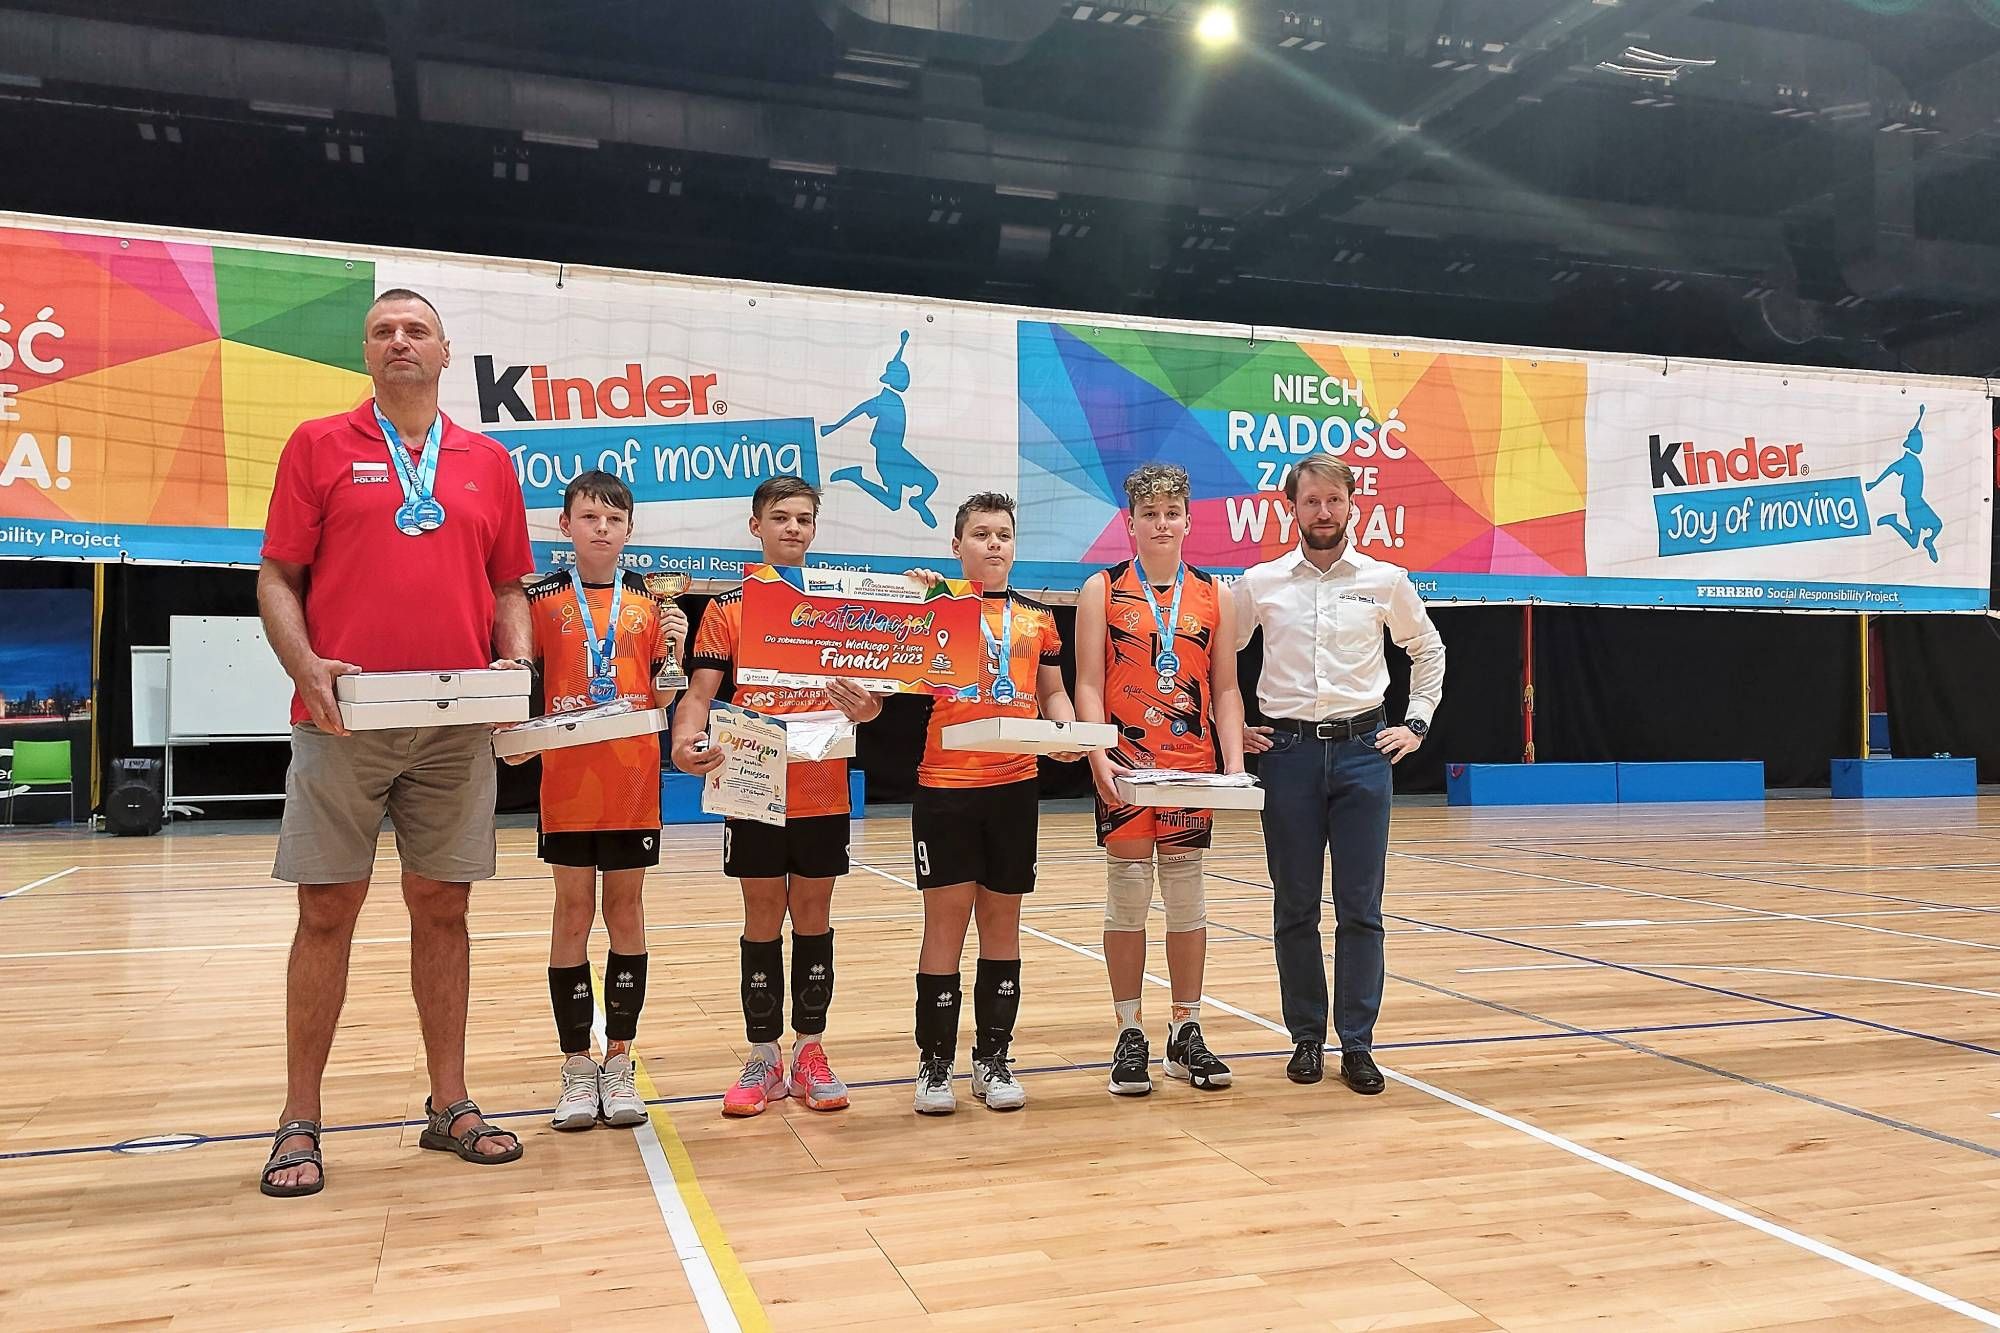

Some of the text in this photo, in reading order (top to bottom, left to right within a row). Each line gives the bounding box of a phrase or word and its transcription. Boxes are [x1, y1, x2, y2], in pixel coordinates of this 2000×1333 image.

[1273, 374, 1364, 406] NIECH
[1228, 407, 1407, 460] RADOŚĆ
[597, 439, 641, 482] of
[655, 436, 802, 482] moving
[1226, 497, 1406, 548] WYRA!
[1667, 491, 1859, 544] Joy of moving
[51, 528, 121, 549] Project
[659, 556, 705, 570] Social
[536, 581, 560, 595] VIGO
[1696, 586, 1899, 604] FERRERO Social Responsibility Project
[791, 602, 935, 642] Gratulacje!
[764, 635, 776, 643] Do
[845, 640, 891, 655] Wielkiego
[892, 653, 923, 664] 2023
[917, 840, 930, 876] 9
